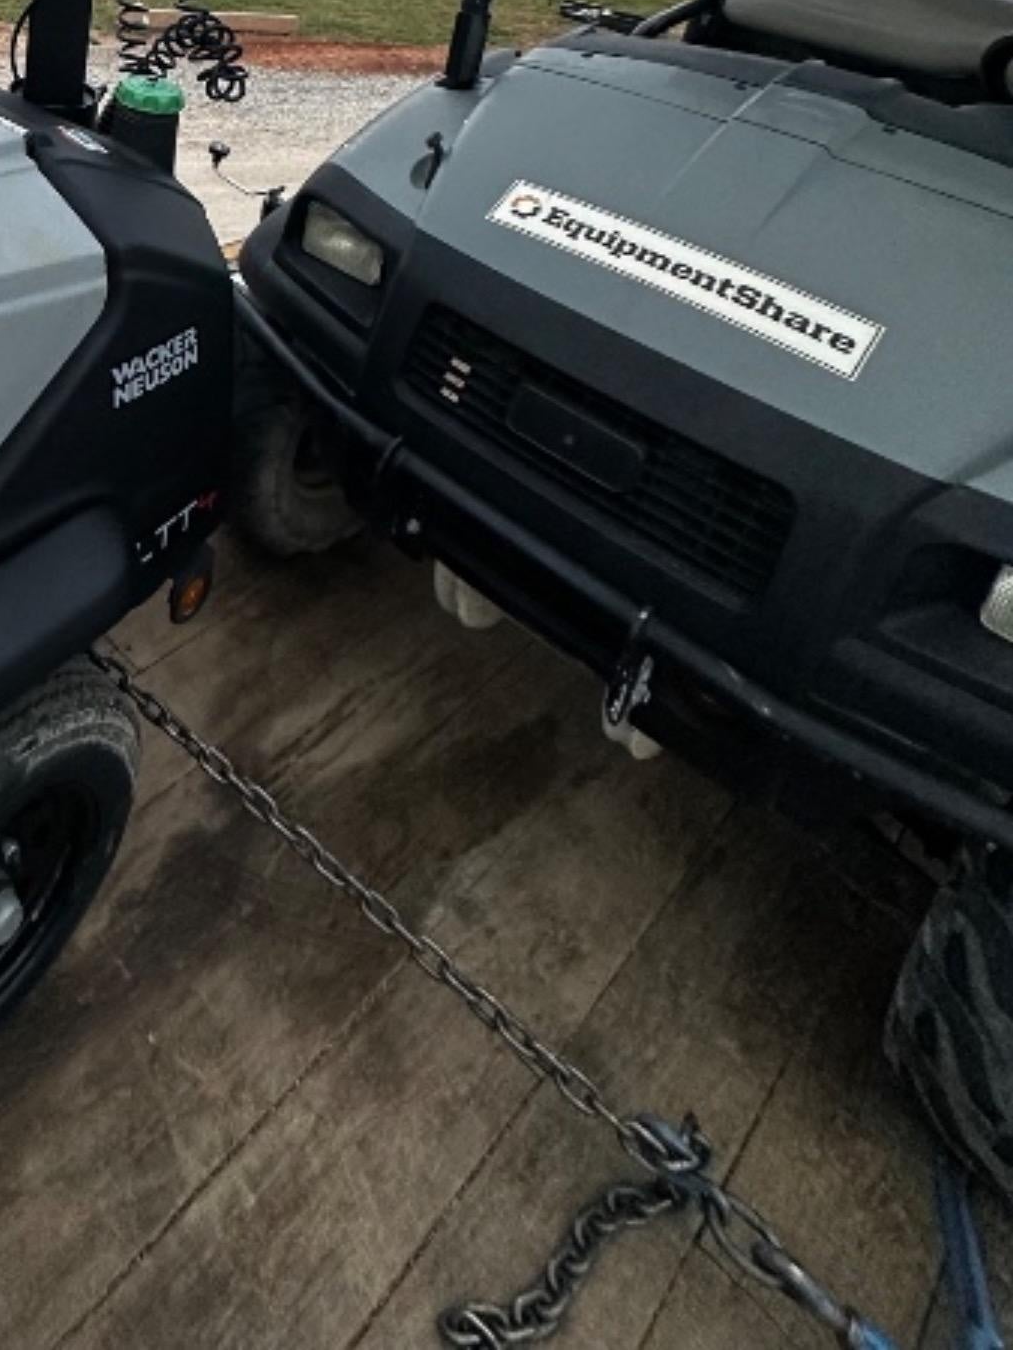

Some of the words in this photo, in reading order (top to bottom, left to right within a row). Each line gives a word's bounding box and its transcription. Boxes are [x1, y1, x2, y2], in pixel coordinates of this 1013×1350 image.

[540, 205, 856, 355] EquipmentShare
[111, 326, 199, 386] WACKER
[111, 341, 199, 409] NEUSON
